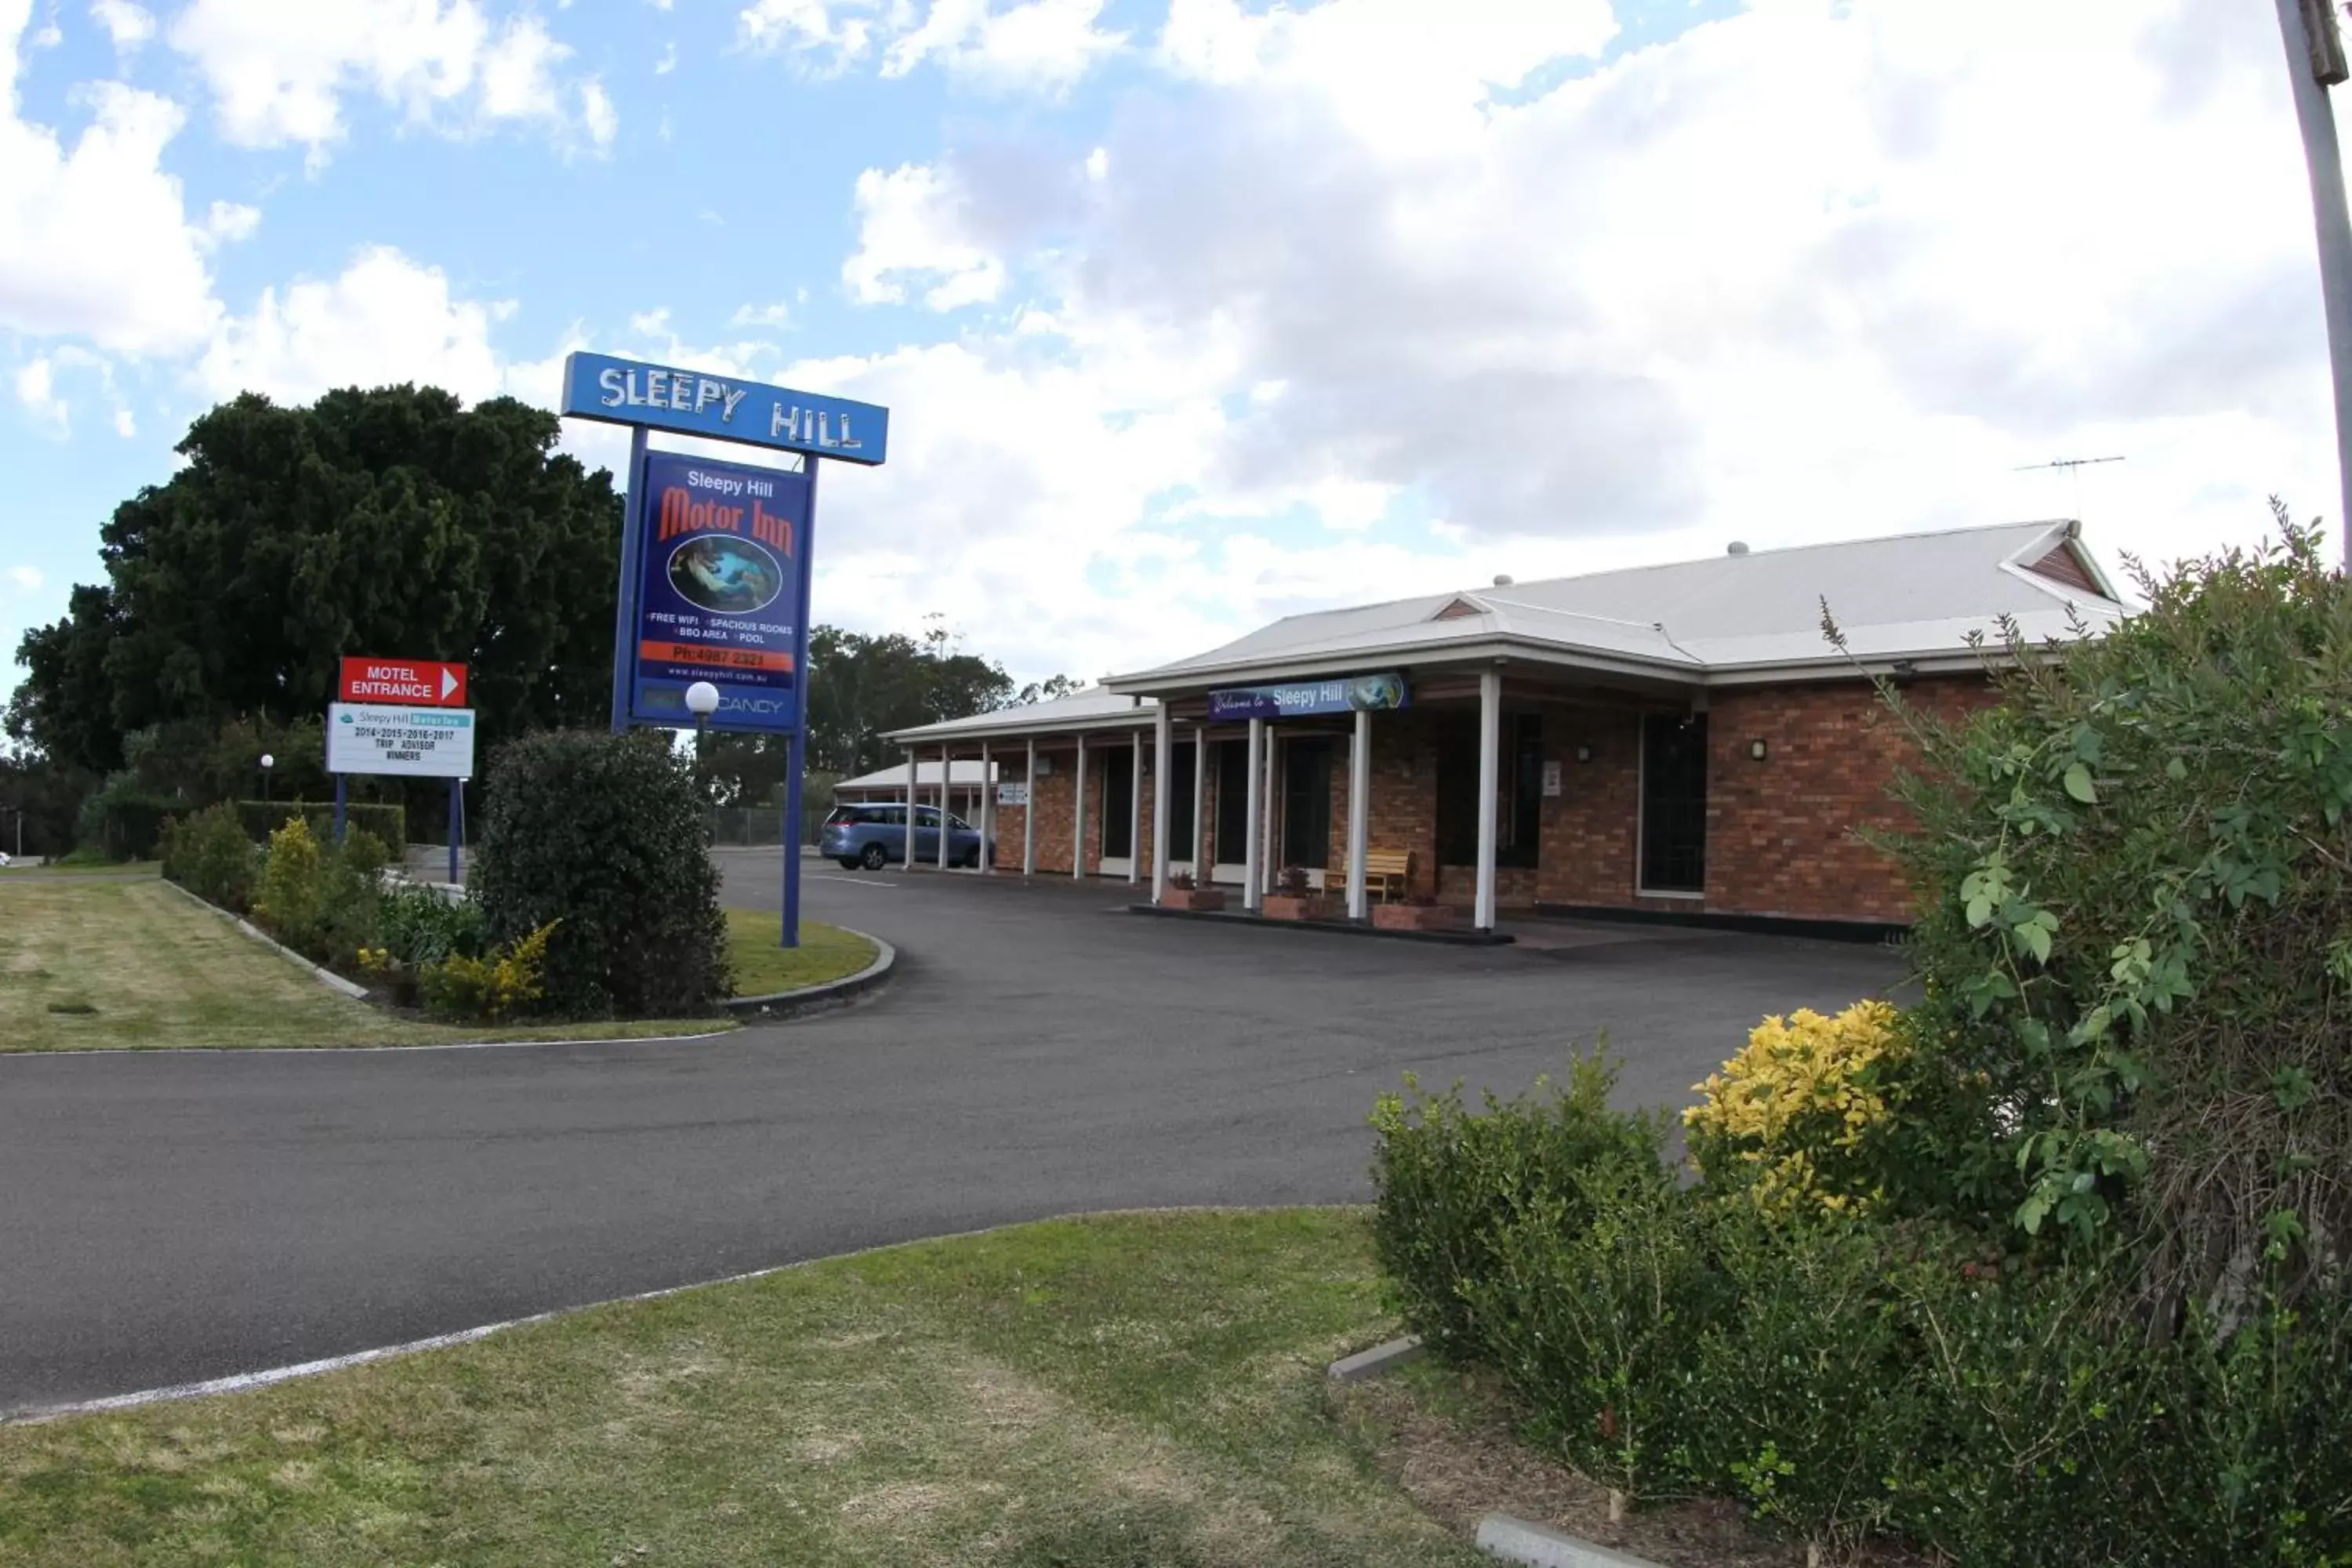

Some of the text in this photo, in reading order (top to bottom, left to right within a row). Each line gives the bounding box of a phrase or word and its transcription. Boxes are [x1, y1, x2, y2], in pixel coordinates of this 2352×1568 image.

[600, 368, 862, 449] SLEEPY HILL
[688, 470, 773, 498] Sleepy Hill
[659, 486, 793, 560] Motor Inn
[650, 612, 793, 636] FREE WIFI SPACIOUS ROOMS
[702, 630, 728, 641] AREA
[739, 633, 765, 644] POOL
[368, 666, 418, 681] MOTEL
[352, 681, 432, 698] ENTRANCE
[1273, 688, 1316, 709] Sleepy
[1320, 683, 1342, 702] Hill
[718, 697, 782, 714] CANCY
[358, 710, 390, 724] Sleepy
[393, 714, 408, 724] Hill
[375, 739, 435, 752] TRIP ADVISOR
[387, 750, 421, 760] WINNERS
